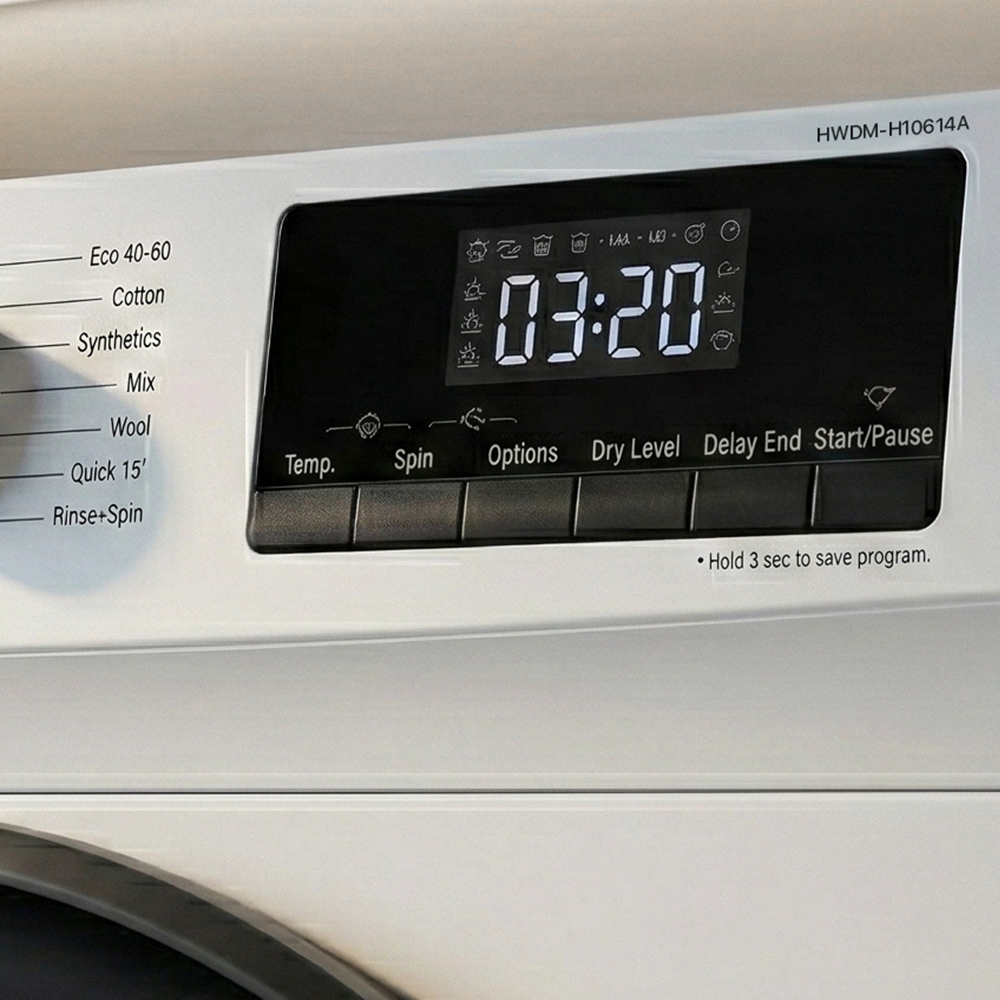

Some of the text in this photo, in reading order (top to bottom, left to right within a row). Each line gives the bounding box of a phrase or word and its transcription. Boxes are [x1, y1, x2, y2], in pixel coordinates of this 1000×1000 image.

[817, 115, 970, 142] HWDM-H10614A
[89, 240, 172, 267] Eco 40-60
[111, 286, 166, 308] Cotton
[493, 260, 706, 367] 03:20
[77, 328, 162, 357] Synthetics
[125, 371, 157, 394] Mix
[109, 413, 152, 438] Wool
[812, 424, 935, 452] Start/Pause
[486, 442, 560, 469] Options
[591, 433, 682, 466] Dry Level
[702, 428, 803, 459] Delay End
[70, 459, 117, 486] Quick
[284, 452, 337, 479] Temp.
[393, 446, 435, 474] Spin
[52, 503, 144, 529] Rinse+Spin
[708, 548, 932, 570] Hold 3 sec to save program.
